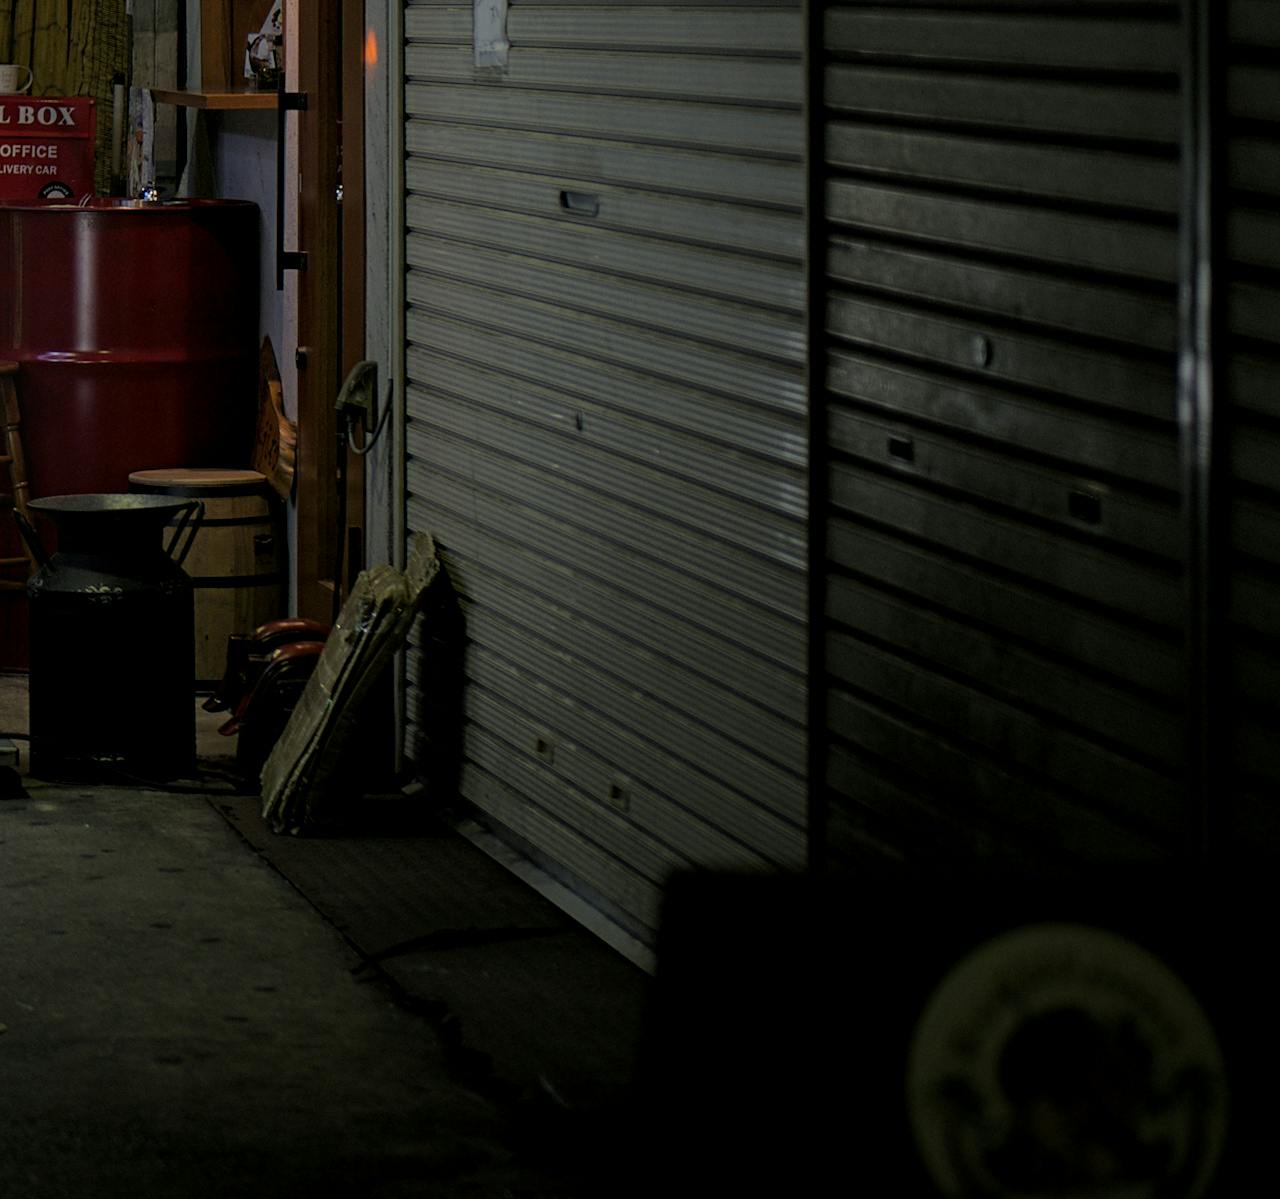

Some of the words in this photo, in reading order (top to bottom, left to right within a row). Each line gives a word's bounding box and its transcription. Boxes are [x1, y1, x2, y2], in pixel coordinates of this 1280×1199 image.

[16, 104, 77, 128] BOX
[0, 144, 58, 159] OFFICE
[35, 164, 57, 176] CAR
